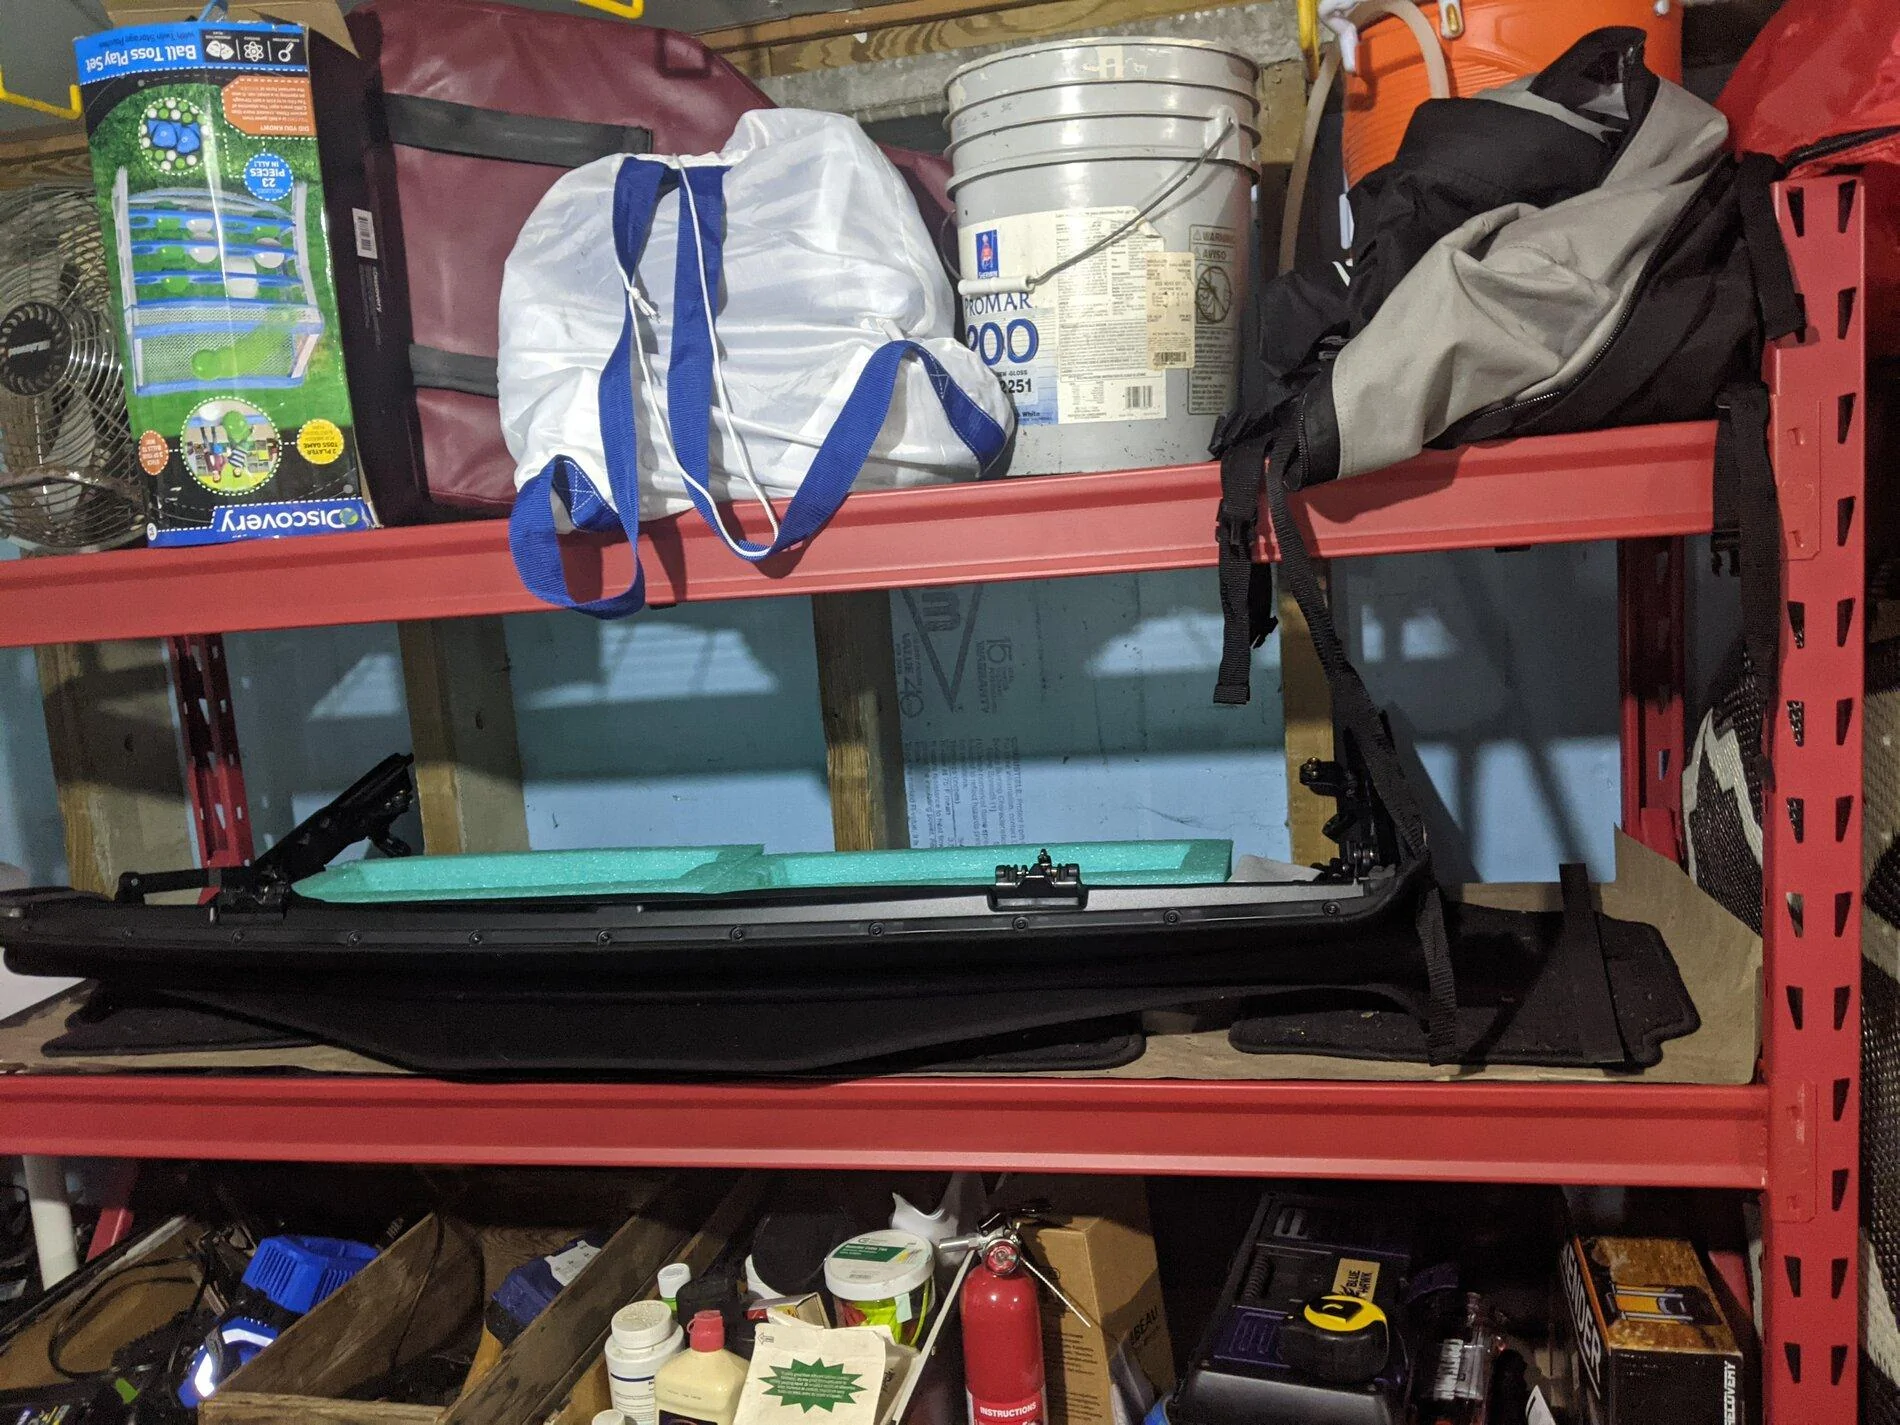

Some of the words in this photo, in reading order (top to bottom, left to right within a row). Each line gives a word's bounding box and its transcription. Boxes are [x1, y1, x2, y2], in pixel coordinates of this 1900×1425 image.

[177, 32, 195, 41] with
[105, 50, 128, 67] Play
[130, 47, 164, 62] Toss
[165, 45, 196, 61] Ball
[85, 56, 104, 73] Set
[250, 168, 285, 177] PIECES
[262, 177, 276, 187] 23
[1202, 250, 1227, 260] AVISO
[964, 292, 1032, 317] PROMAR
[221, 508, 343, 532] Discovery
[988, 637, 1012, 663] 15
[900, 676, 924, 718] 40
[1346, 1270, 1360, 1287] BLUE
[1358, 1272, 1372, 1293] HAWK
[979, 1402, 1037, 1418] INSTRUCTIONS
